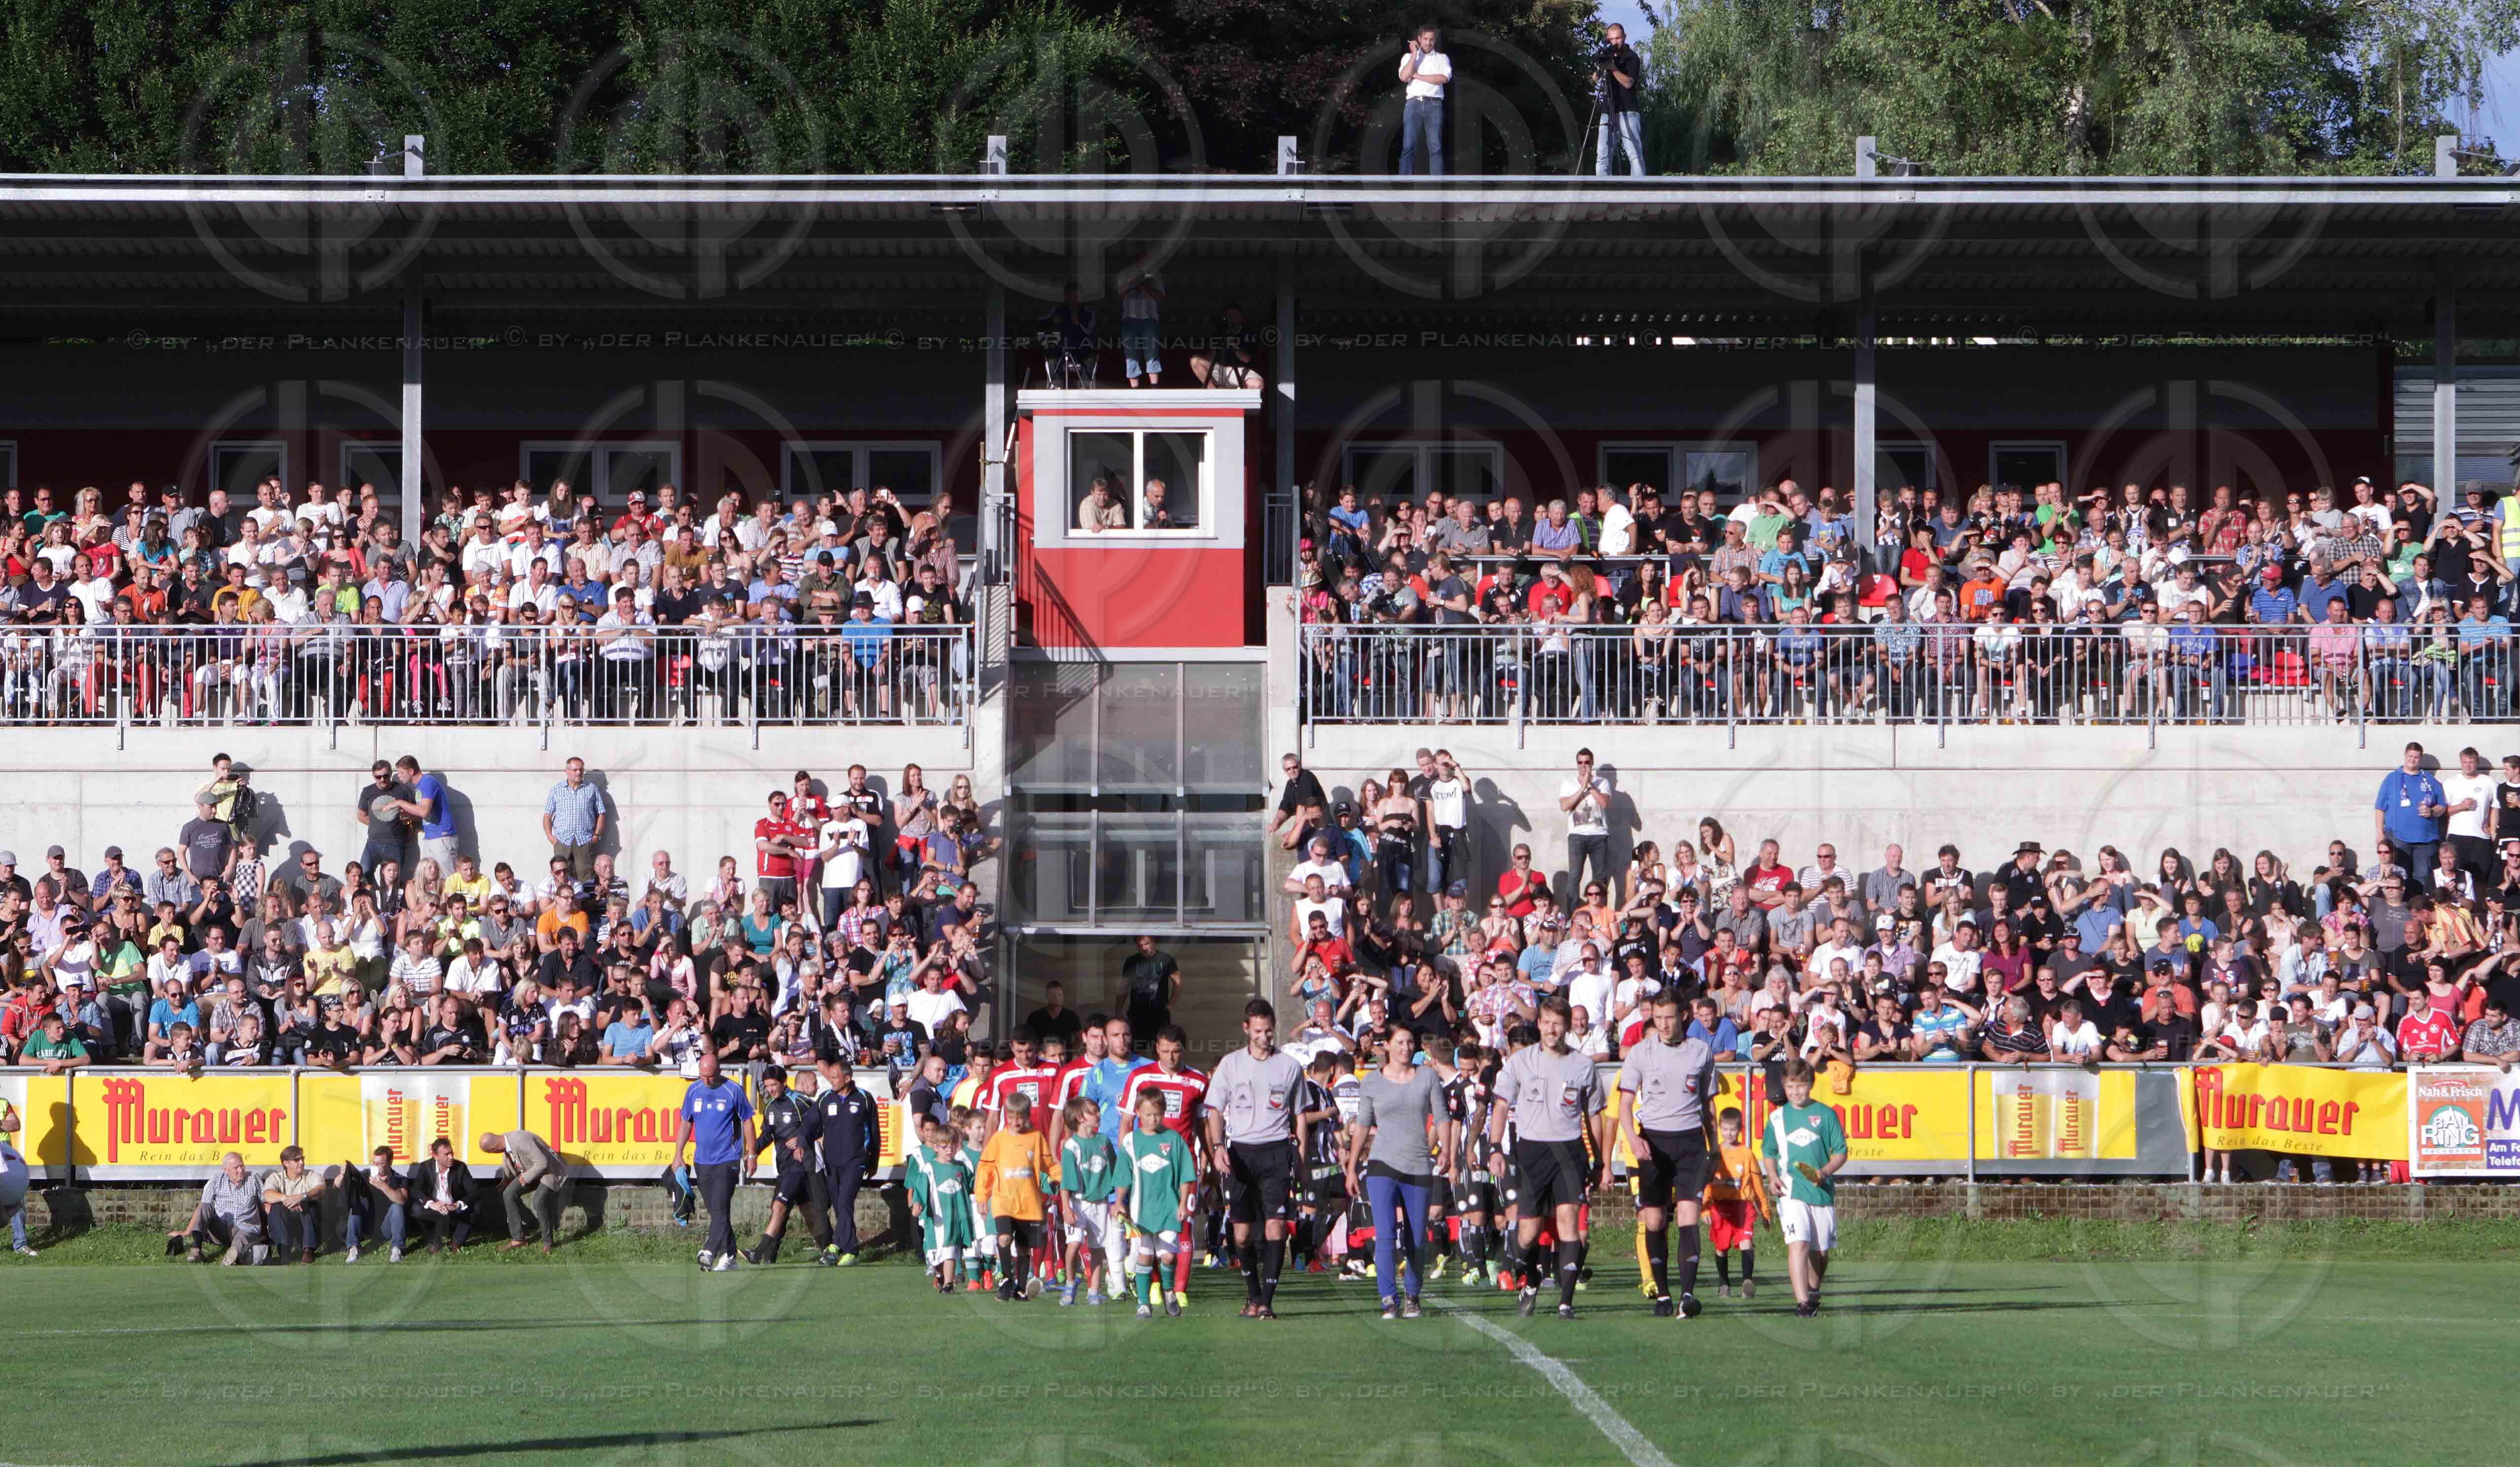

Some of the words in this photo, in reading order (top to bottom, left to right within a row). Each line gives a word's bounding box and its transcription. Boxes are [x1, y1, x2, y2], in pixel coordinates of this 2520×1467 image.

[102, 1078, 286, 1163] Murauer
[544, 1077, 695, 1153] Murau
[2008, 1083, 2040, 1157] Murauer
[2058, 1090, 2084, 1153] Murauer
[2217, 1135, 2246, 1146] Rein
[2252, 1135, 2275, 1147] das
[2283, 1139, 2323, 1152] Beste
[2421, 1124, 2481, 1147] RING
[2489, 1142, 2507, 1152] Am
[140, 1151, 172, 1161] Rein
[179, 1151, 204, 1161] das
[583, 1150, 616, 1160] Rein
[622, 1150, 647, 1160] das
